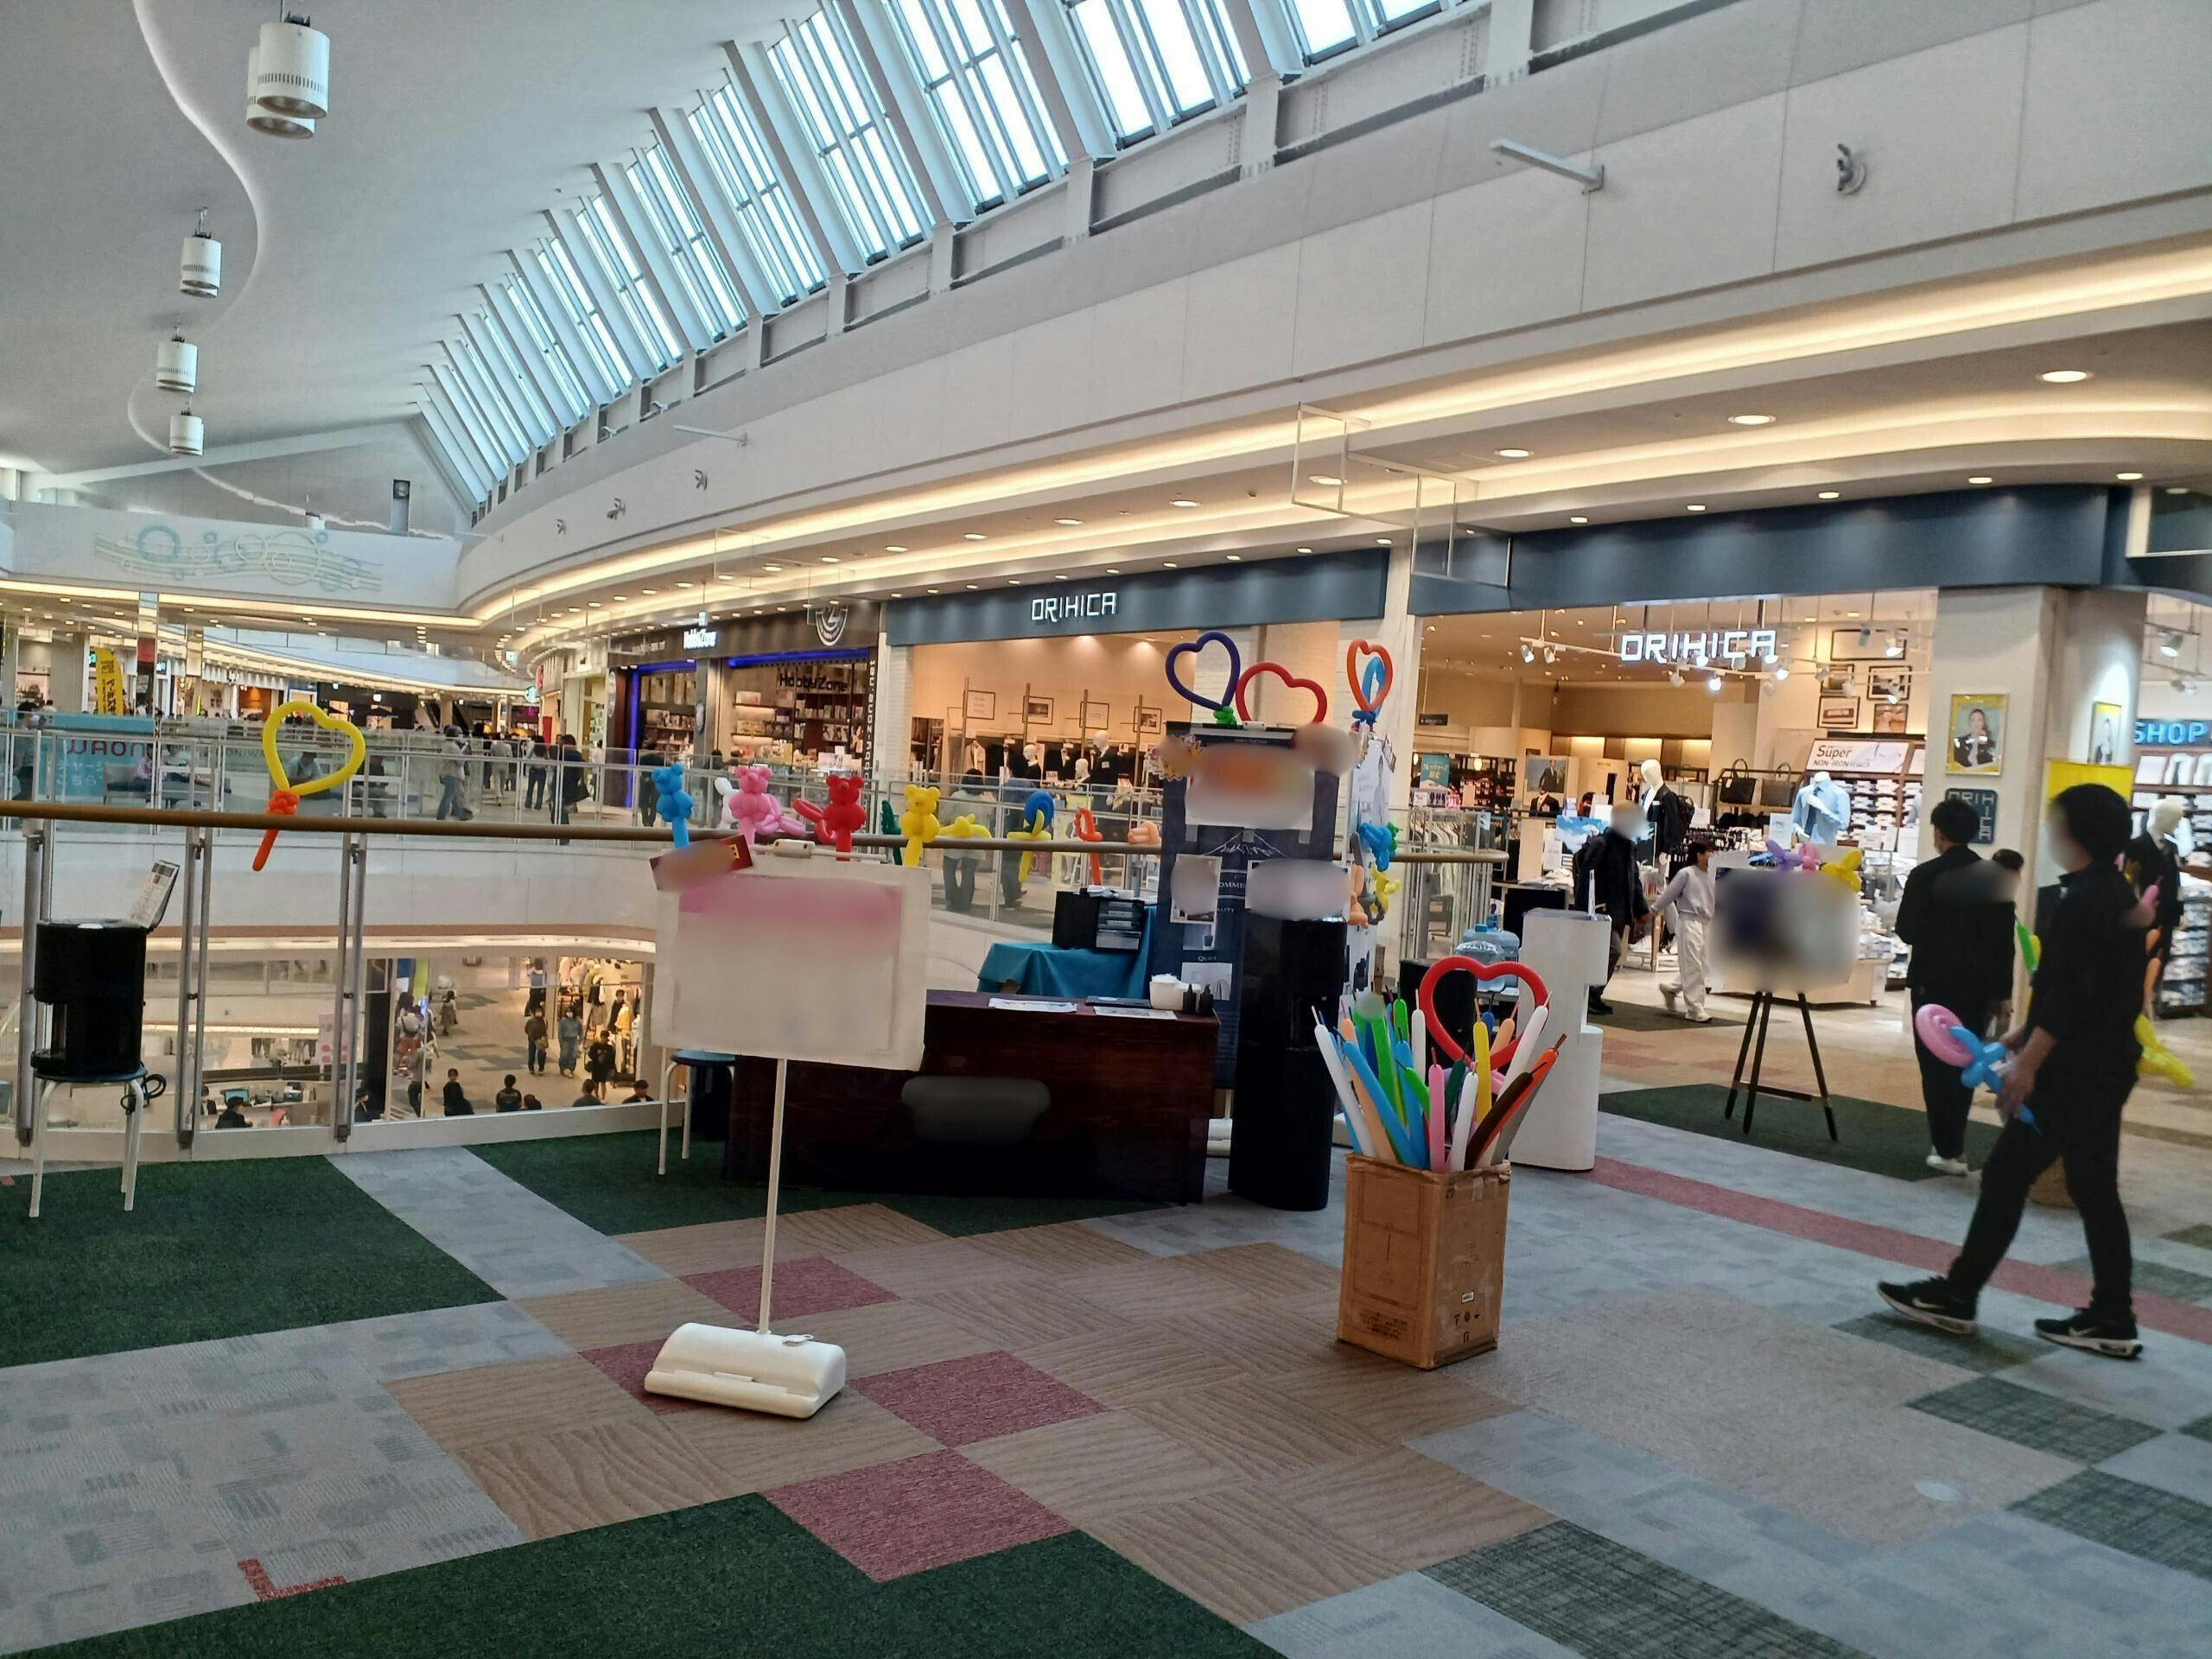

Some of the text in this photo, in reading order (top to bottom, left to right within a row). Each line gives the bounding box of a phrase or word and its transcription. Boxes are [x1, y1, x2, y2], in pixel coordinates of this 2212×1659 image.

[1031, 592, 1116, 622] ORIHICA
[1620, 630, 1777, 664] ORIHICA
[2134, 721, 2209, 744] SHOP
[1816, 745, 1852, 760] Super
